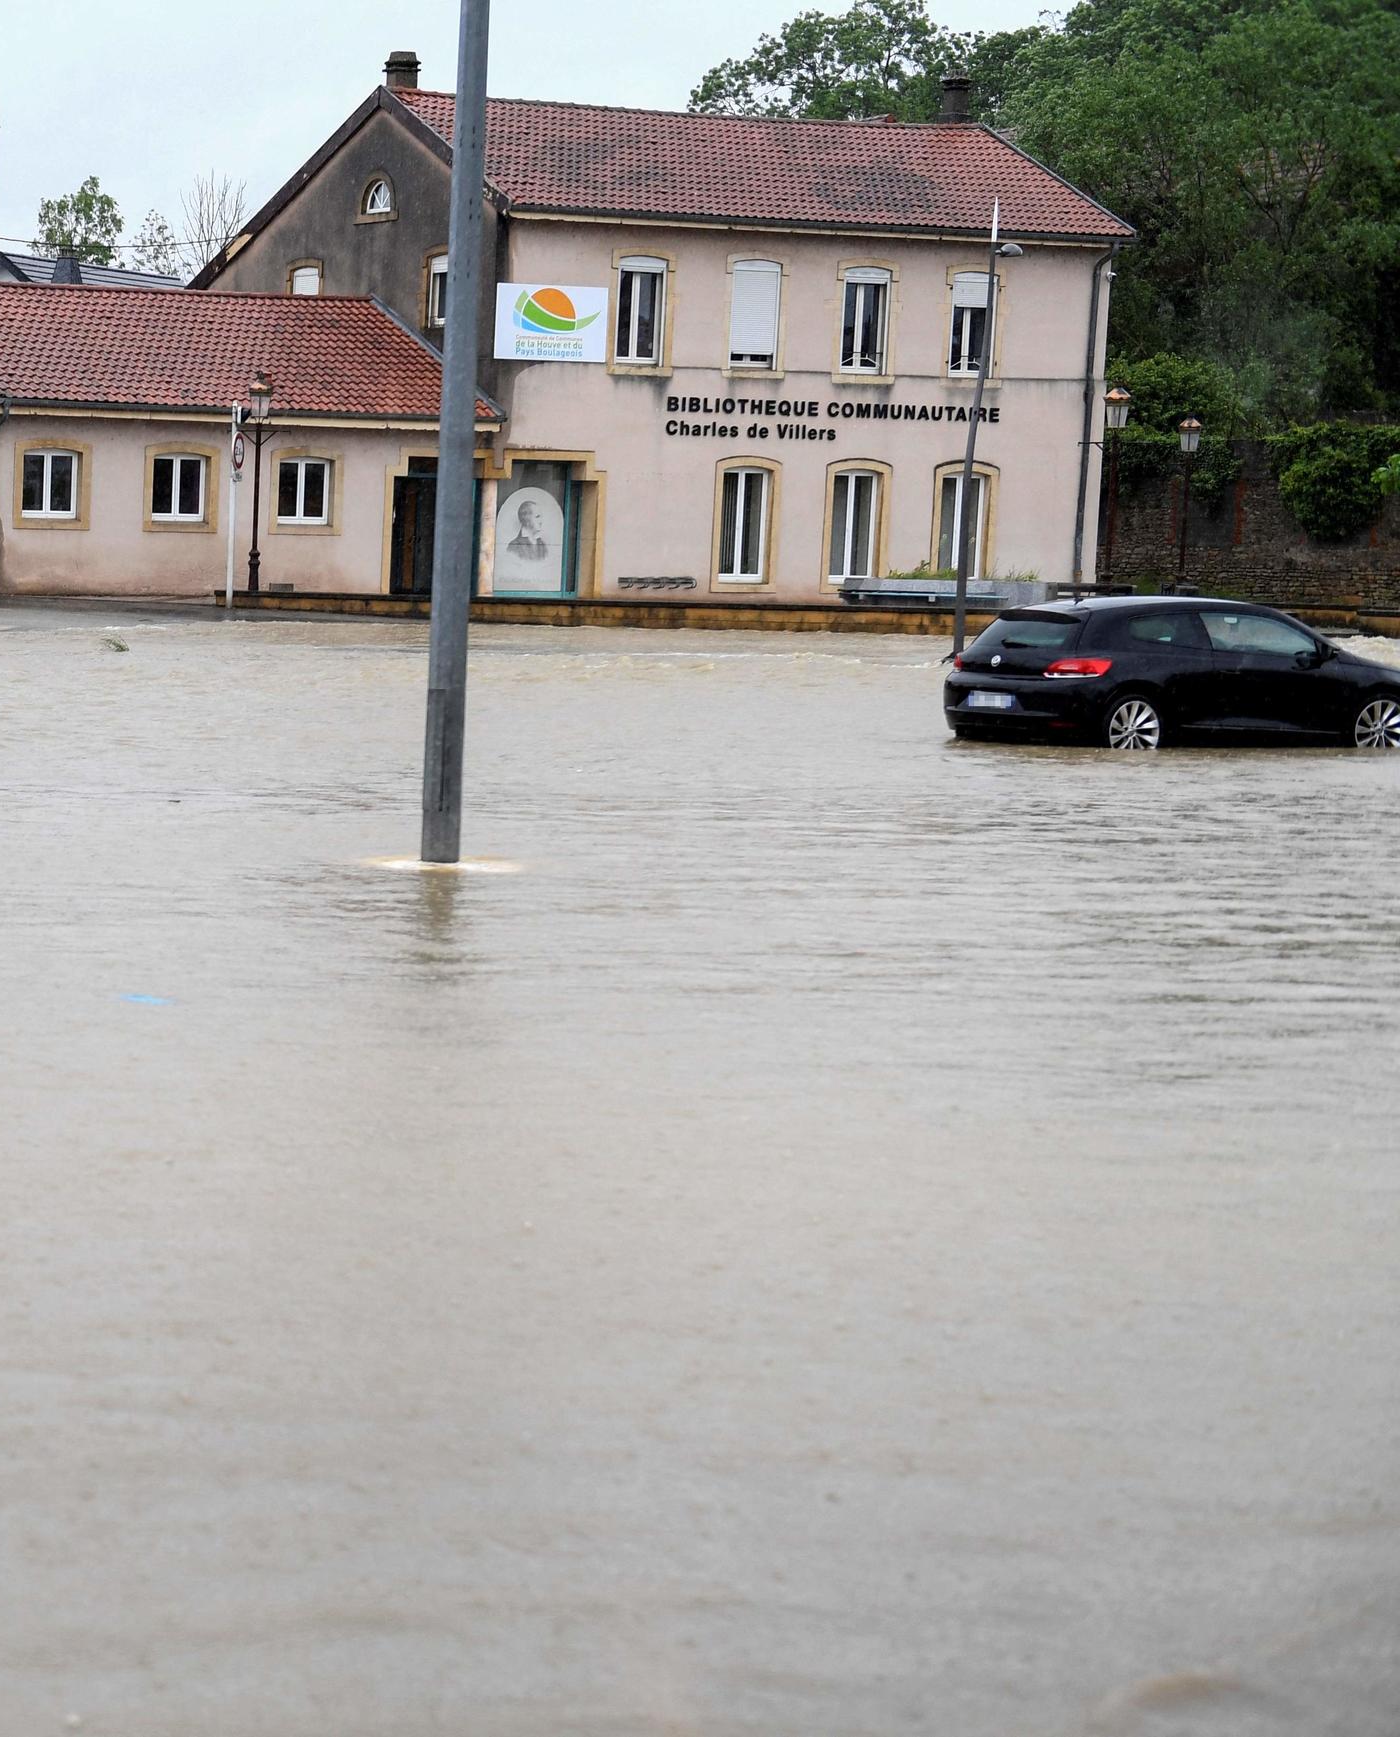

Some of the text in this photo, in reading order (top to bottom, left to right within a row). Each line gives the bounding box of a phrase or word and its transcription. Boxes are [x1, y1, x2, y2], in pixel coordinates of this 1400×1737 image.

[515, 347, 583, 358] Pays Boulageois
[537, 340, 561, 349] Houve
[563, 341, 571, 349] et
[572, 341, 583, 349] du
[666, 396, 1001, 423] BIBLIOTHEQUE COMMUNAUTAIRE
[665, 420, 837, 441] Charles de Villers
